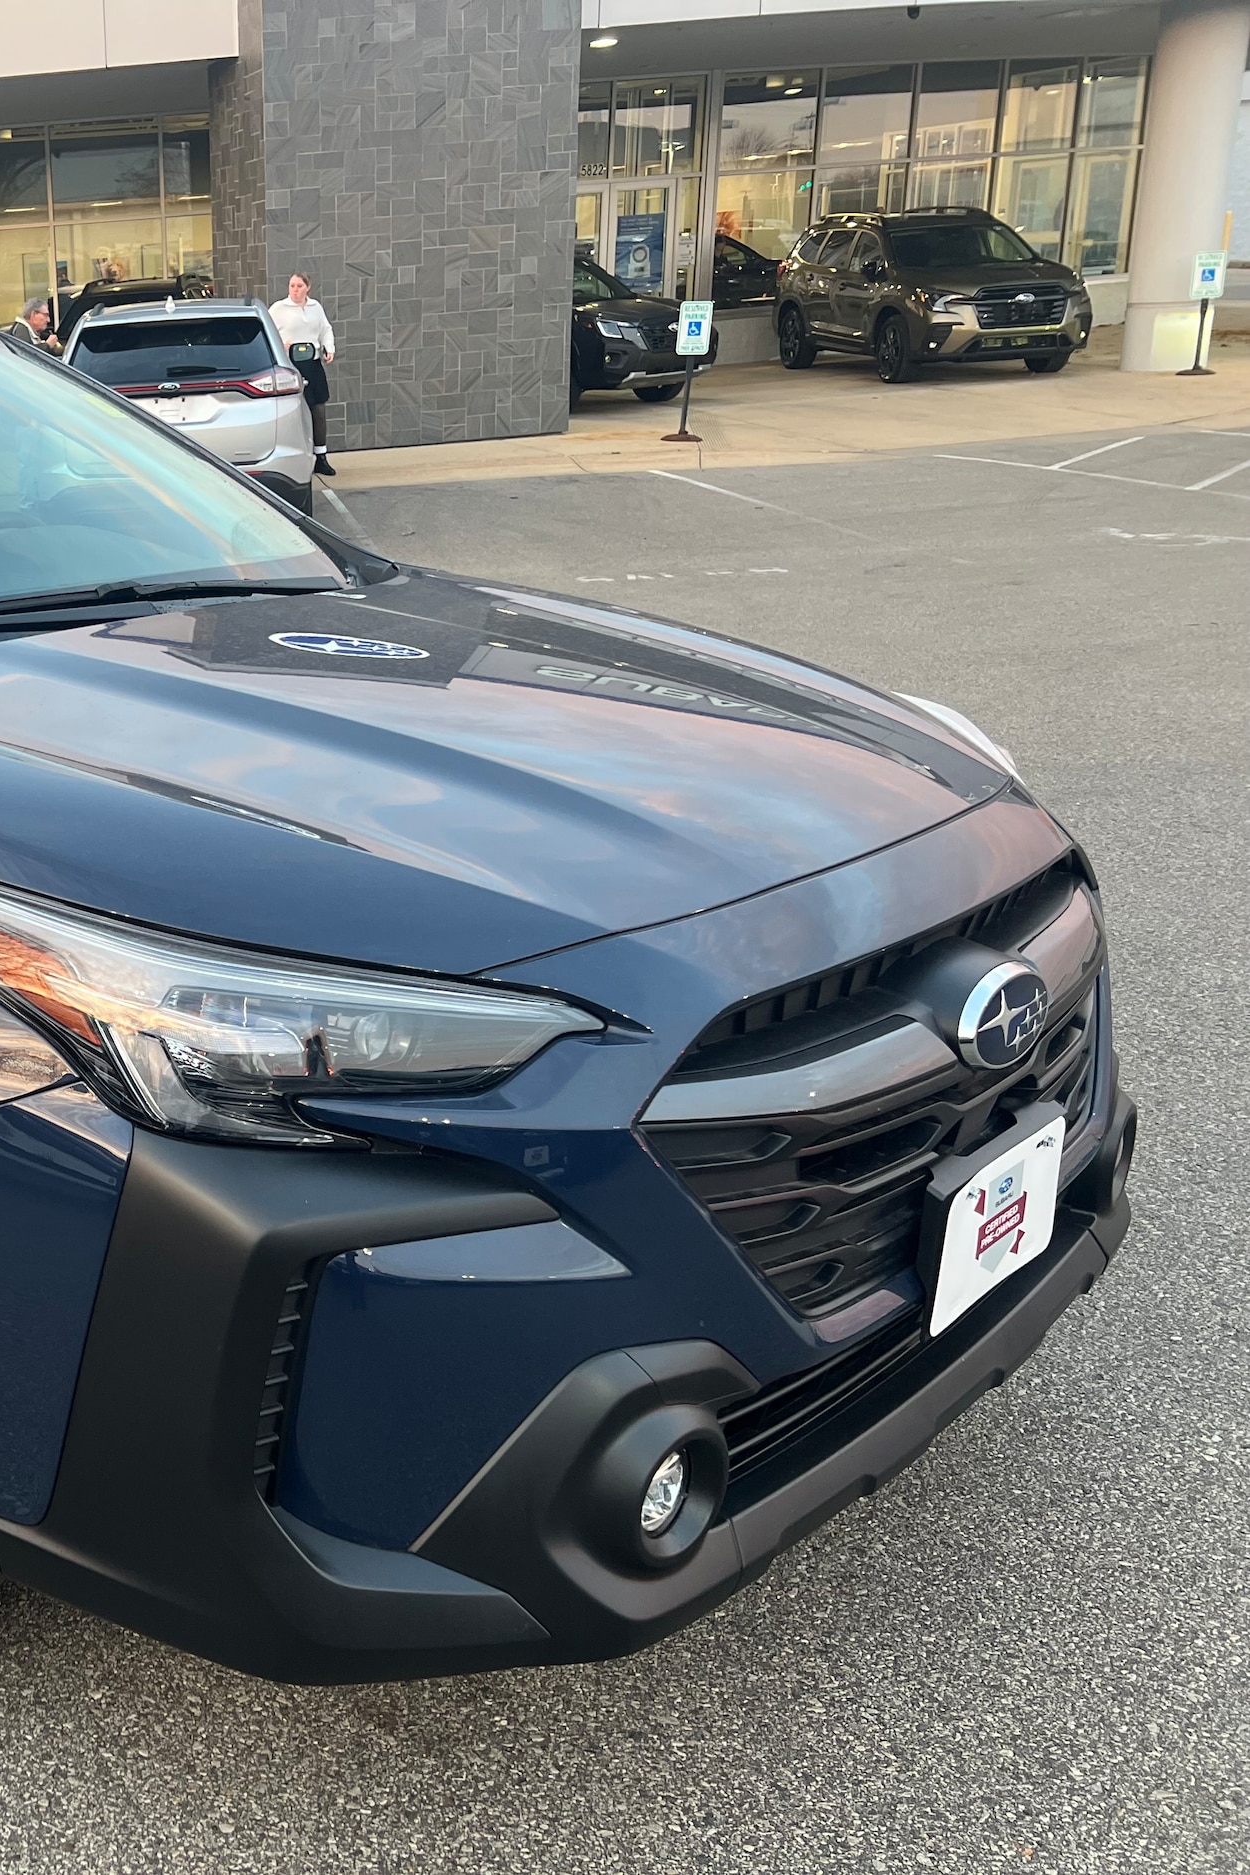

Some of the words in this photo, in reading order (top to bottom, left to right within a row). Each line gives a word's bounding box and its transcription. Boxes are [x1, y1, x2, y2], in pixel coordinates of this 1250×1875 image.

[582, 164, 603, 176] 5822
[980, 1213, 1021, 1249] PRE-OWNED
[985, 1204, 1019, 1235] CERTIFIED
